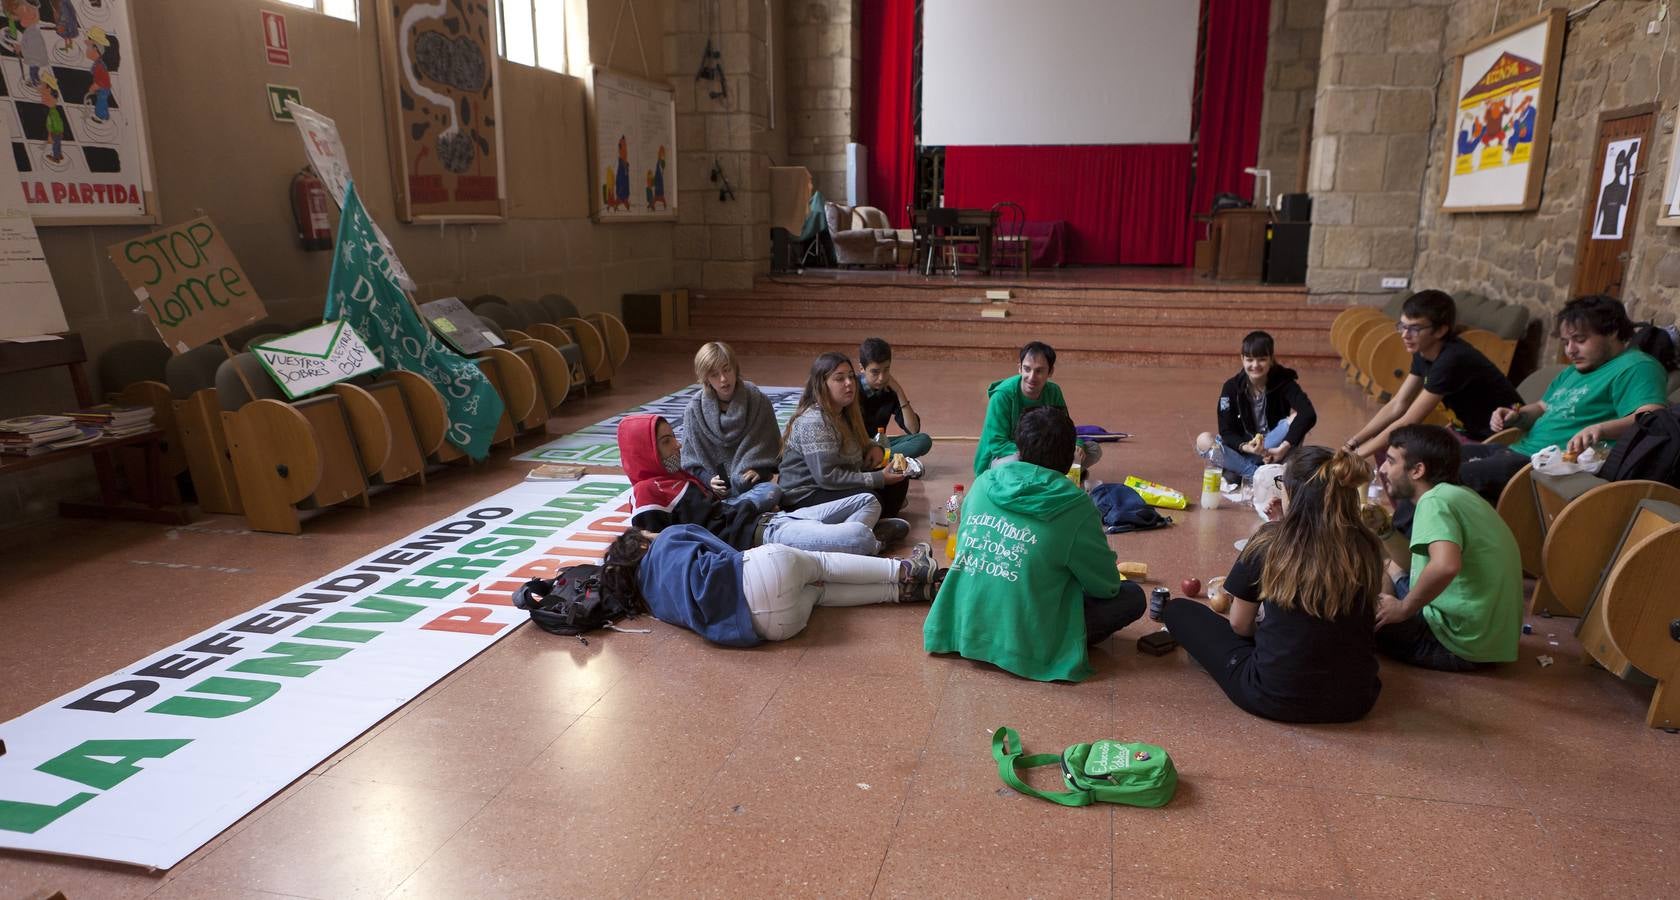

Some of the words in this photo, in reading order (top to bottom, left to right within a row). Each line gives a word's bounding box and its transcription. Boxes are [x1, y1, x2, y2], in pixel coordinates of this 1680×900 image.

[21, 181, 49, 204] LA
[51, 181, 141, 204] PARTIDA
[125, 222, 214, 285] STOP
[264, 353, 327, 367] VUESTROS
[338, 342, 366, 376] BECAS
[277, 368, 331, 384] SOBRES
[966, 515, 1002, 533] ESCUELA
[965, 536, 980, 549] DE
[419, 503, 632, 635] PÚBLIC
[63, 507, 514, 714] DEFENDIENDO
[0, 739, 196, 834] LA
[145, 482, 632, 718] UNIVERSIDAD
